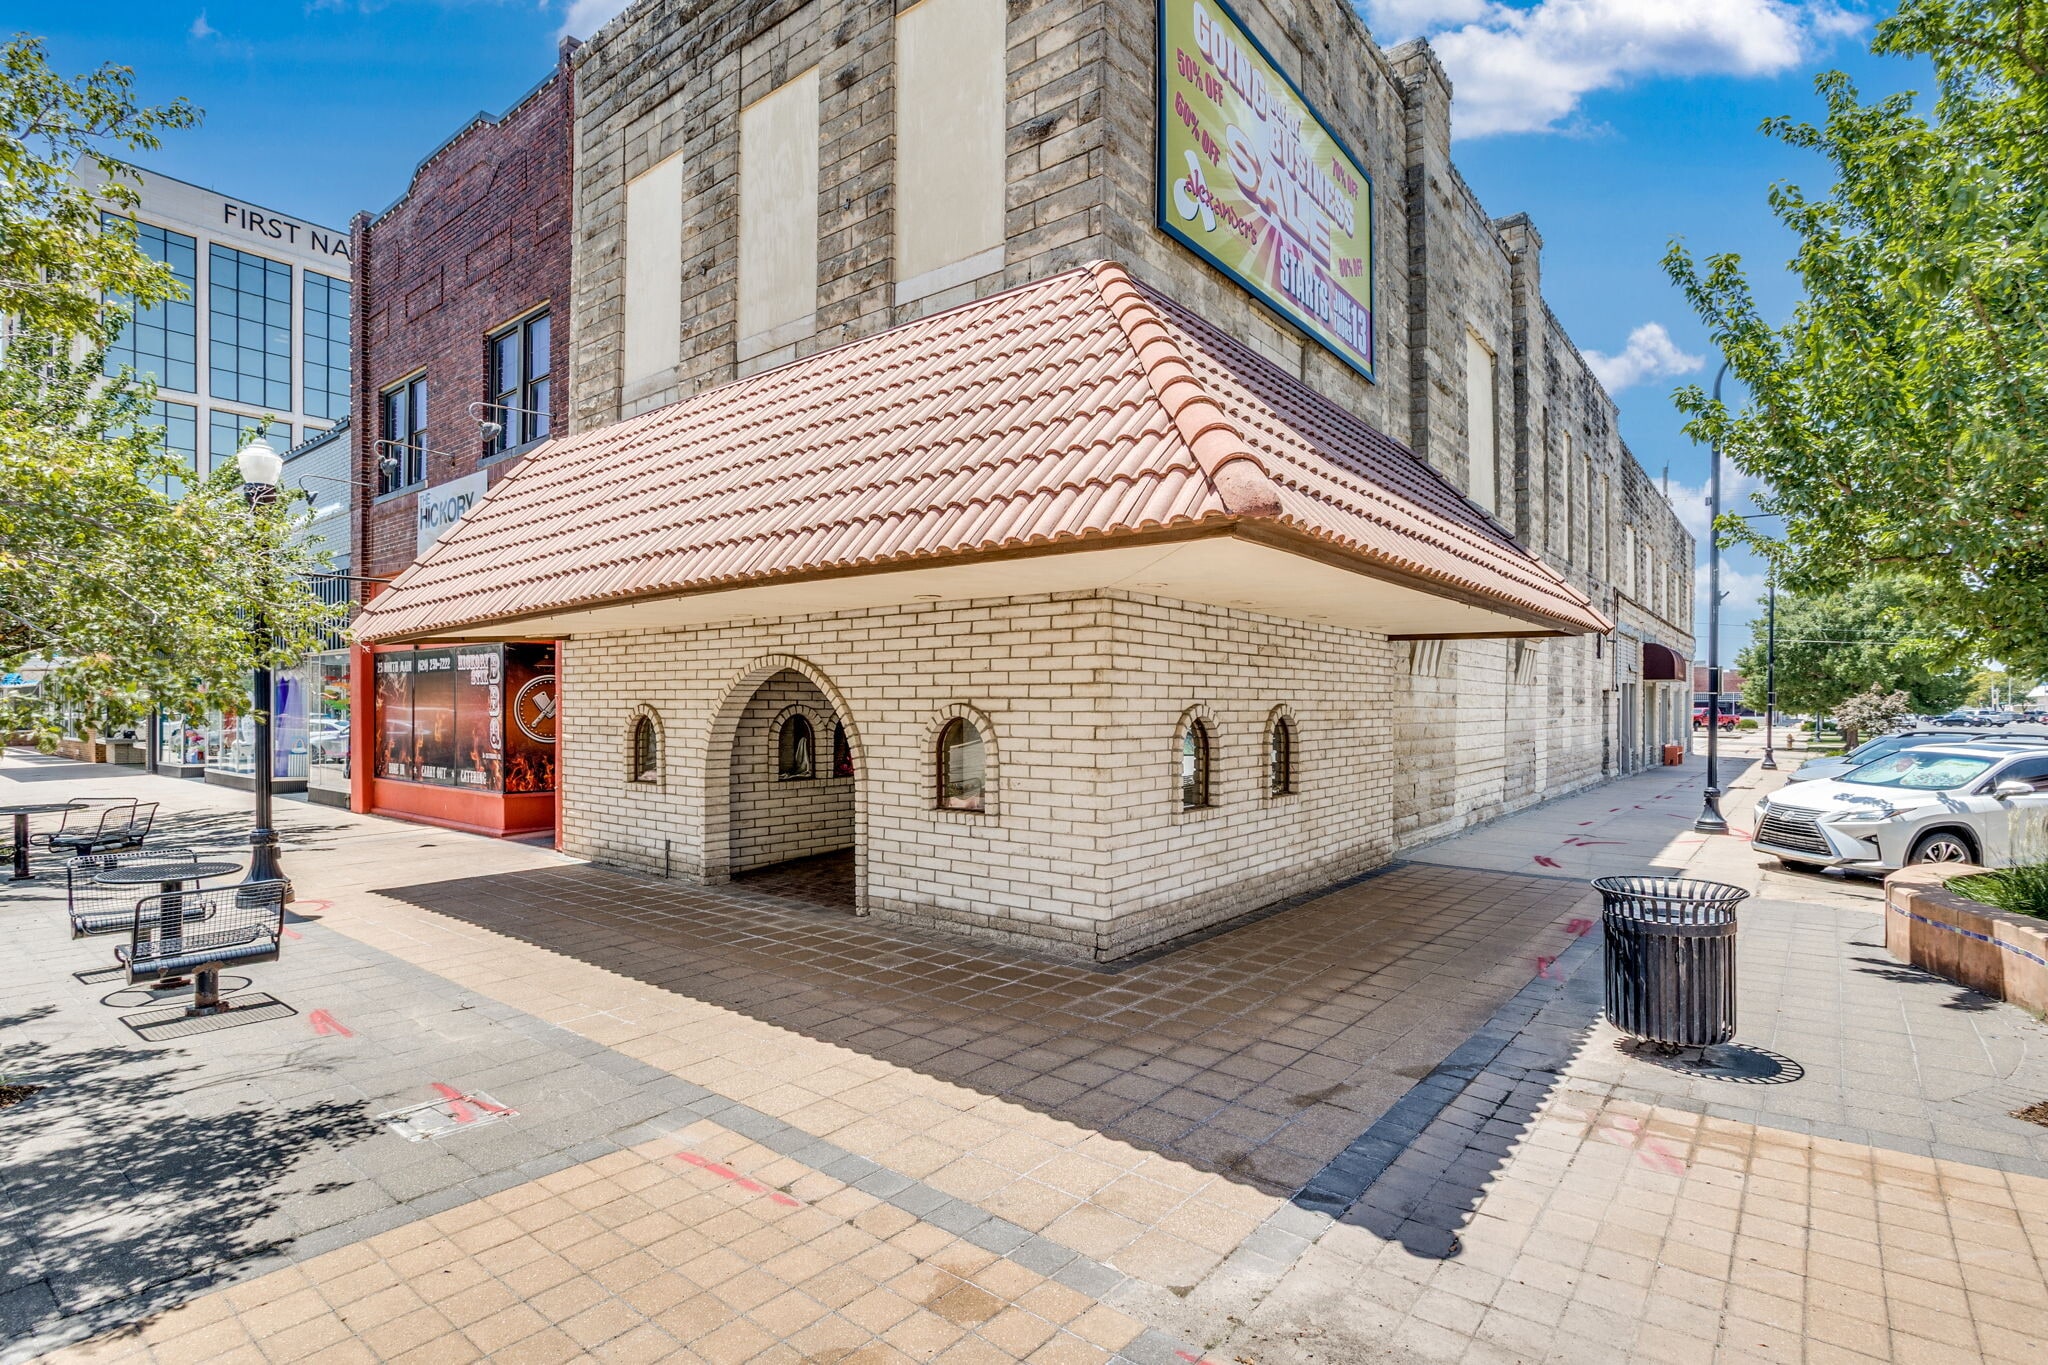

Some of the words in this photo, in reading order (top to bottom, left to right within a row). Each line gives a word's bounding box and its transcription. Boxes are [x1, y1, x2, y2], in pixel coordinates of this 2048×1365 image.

[1176, 48, 1203, 91] 50%
[1205, 72, 1224, 107] OFF
[1193, 2, 1267, 121] GOING
[1175, 91, 1199, 141] 60%
[1202, 129, 1220, 167] OFF
[1225, 123, 1331, 271] SALE
[1269, 122, 1355, 238] BUSINESS
[1347, 174, 1358, 200] OFF
[225, 203, 301, 244] FIRST
[1280, 245, 1330, 323] STARTS
[1333, 288, 1352, 322] JUNE
[1352, 303, 1367, 355] 13
[420, 492, 431, 507] THE
[420, 491, 474, 530] HICKORY
[421, 765, 436, 778] CARRY
[436, 766, 448, 780] OUT
[460, 769, 487, 785] CATERING
